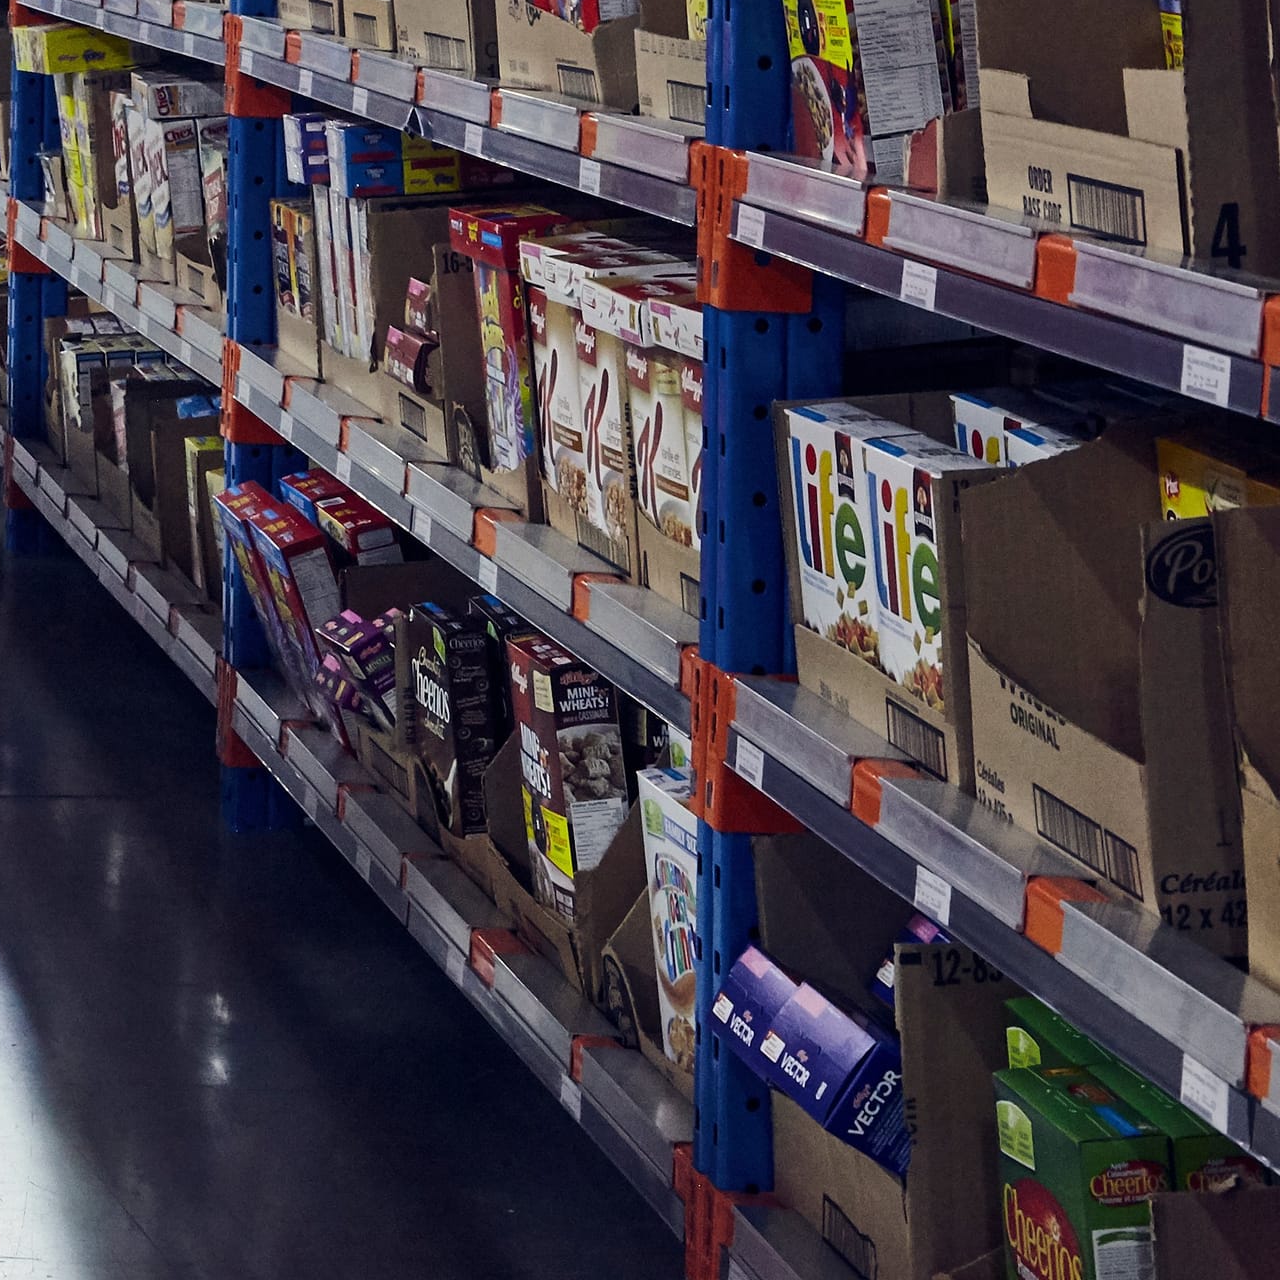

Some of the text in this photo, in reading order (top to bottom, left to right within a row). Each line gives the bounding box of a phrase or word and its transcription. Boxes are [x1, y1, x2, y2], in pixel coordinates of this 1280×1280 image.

[165, 126, 194, 142] Chex
[1028, 165, 1053, 194] ORDER
[1023, 195, 1062, 223] BASE CODE
[1211, 202, 1247, 269] 4
[449, 636, 485, 650] Cheerios
[412, 658, 450, 723] Cheerios
[559, 696, 609, 712] WHEATS!
[1010, 702, 1060, 751] ORIGINAL
[977, 760, 1005, 794] Céréales
[1162, 905, 1213, 930] 12 x
[730, 1013, 755, 1047] VECTOR
[781, 1053, 810, 1088] VECTOR
[849, 1070, 902, 1136] VECTOR
[1090, 1172, 1166, 1198] Cheerios
[1004, 1183, 1082, 1280] Cheerios
